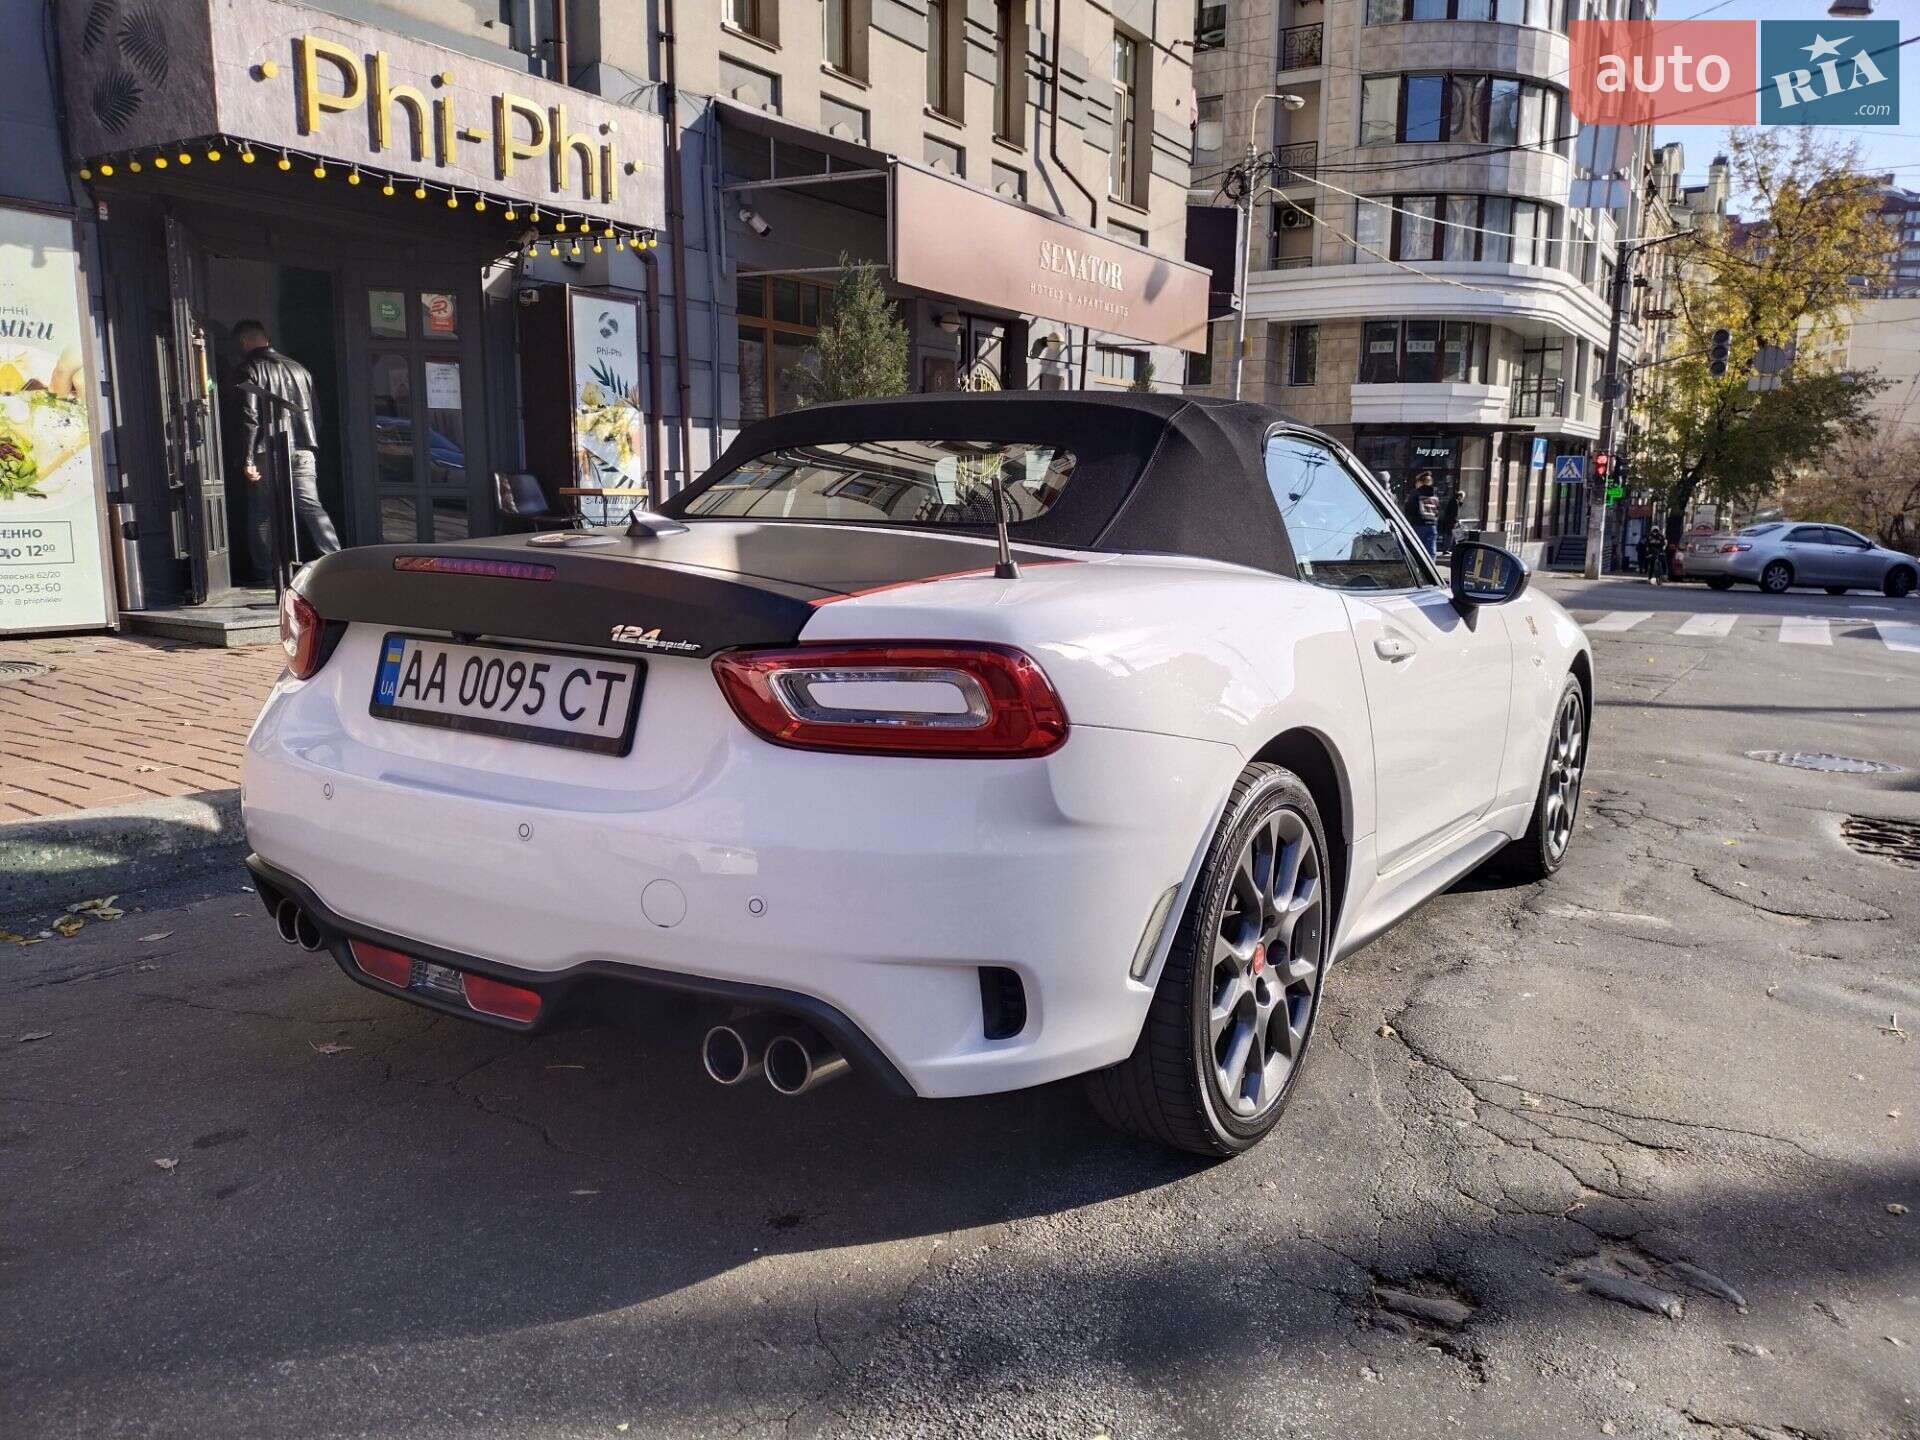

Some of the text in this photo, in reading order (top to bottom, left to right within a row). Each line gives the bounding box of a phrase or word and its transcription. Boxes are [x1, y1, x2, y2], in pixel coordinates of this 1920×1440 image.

[302, 34, 619, 202] Phi-Phi
[1039, 240, 1123, 291] SENATOR
[1029, 281, 1064, 300] HOTELS
[1077, 295, 1129, 317] APARTMENTS
[596, 346, 622, 357] Phi-Phi
[1416, 446, 1449, 457] hey guys
[610, 624, 701, 651] 124 spider
[380, 680, 395, 697] UA
[398, 650, 627, 726] AA 0095 CT
